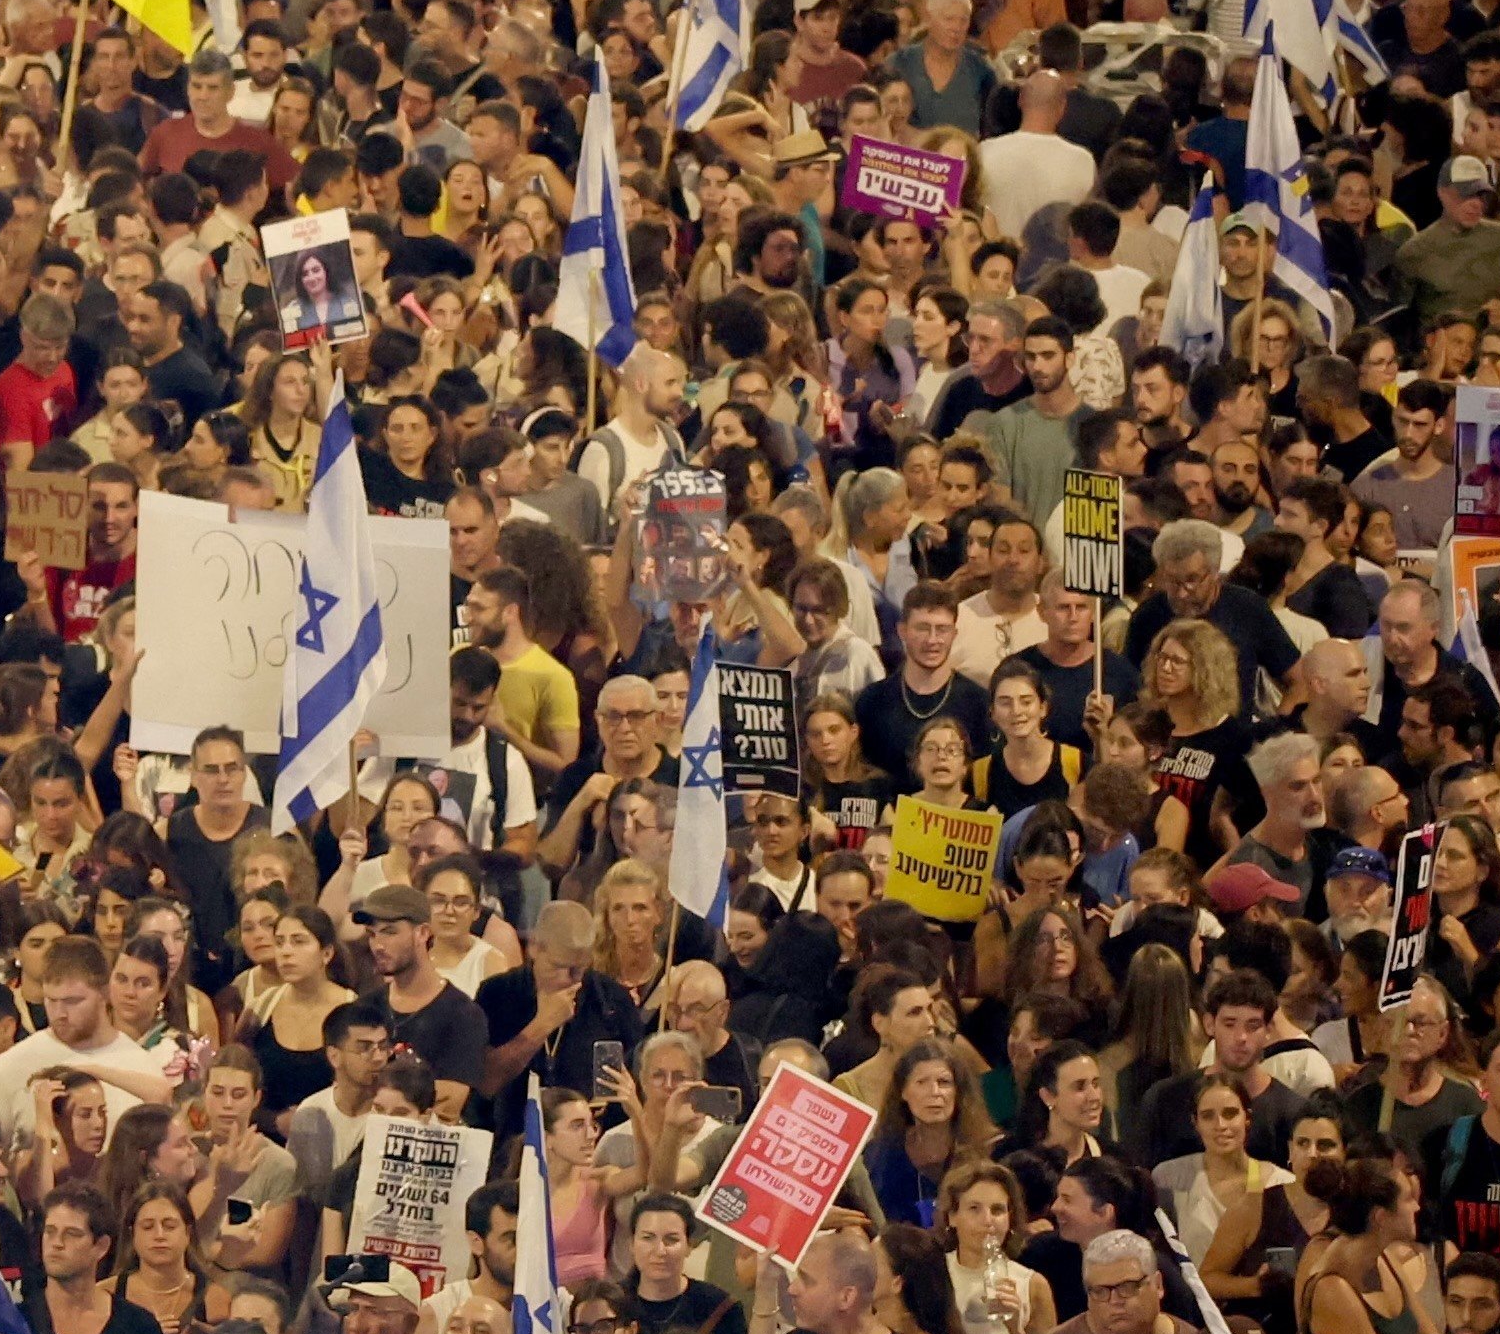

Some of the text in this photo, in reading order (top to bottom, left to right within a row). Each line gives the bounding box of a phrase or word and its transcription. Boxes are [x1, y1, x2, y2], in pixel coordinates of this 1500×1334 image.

[864, 169, 941, 208] עכשיו
[653, 469, 723, 499] בגללך
[1090, 476, 1119, 501] THEM
[1065, 496, 1119, 542] HOME
[1065, 535, 1119, 596] NOW!
[719, 667, 784, 701] תמצא
[735, 702, 785, 732] אותי
[734, 734, 788, 760] טוב?
[896, 851, 984, 896] בולשיטינג
[943, 844, 989, 871] סטופ
[381, 1160, 422, 1176] בארצנו
[385, 1136, 457, 1168] הופקרנו
[748, 1127, 838, 1191] עסקה
[430, 1189, 450, 1205] 64
[744, 1161, 816, 1207] על השולחן
